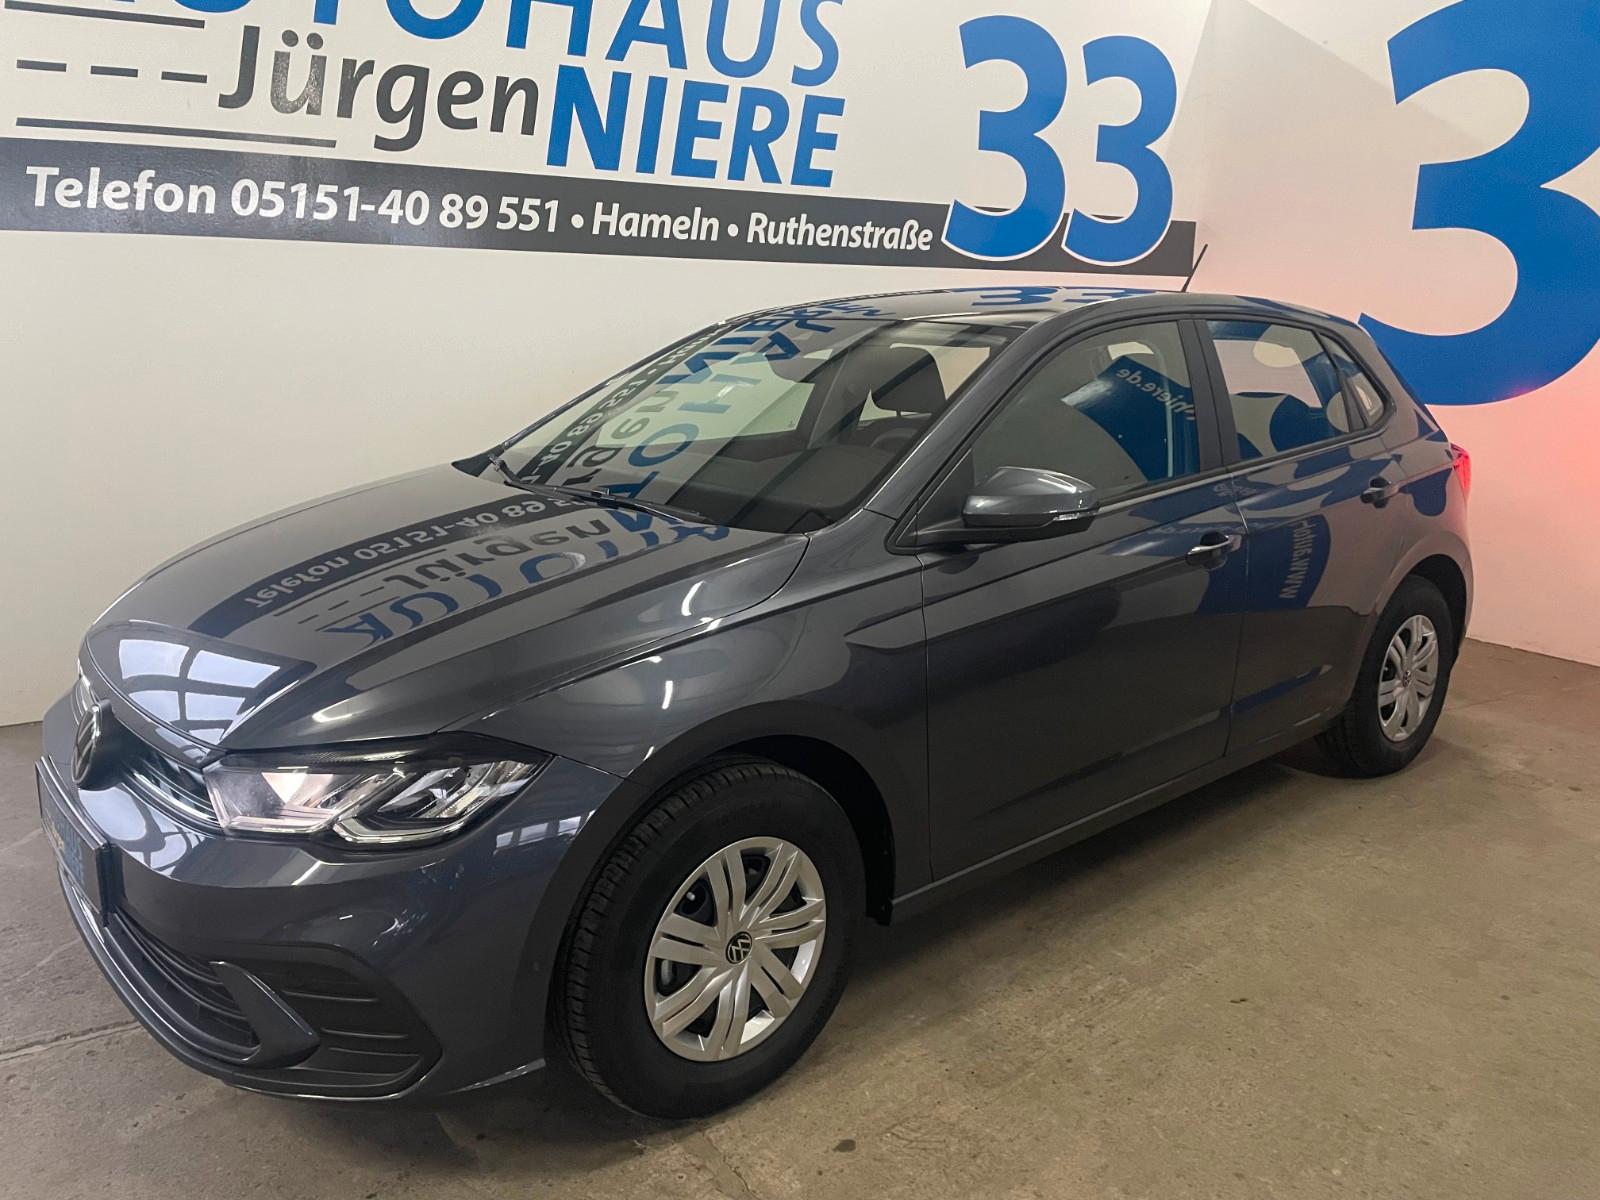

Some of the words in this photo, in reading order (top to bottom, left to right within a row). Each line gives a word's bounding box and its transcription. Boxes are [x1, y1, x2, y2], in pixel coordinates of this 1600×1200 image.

[25, 165, 217, 216] Telefon
[230, 178, 429, 226] 05151-40
[438, 192, 488, 227] 89
[495, 198, 560, 233] 551
[592, 201, 721, 242] Hameln
[746, 211, 934, 252] Ruthenstraße
[941, 14, 1178, 267] 33
[218, 25, 540, 152] Jürgen
[546, 64, 845, 188] NIERE
